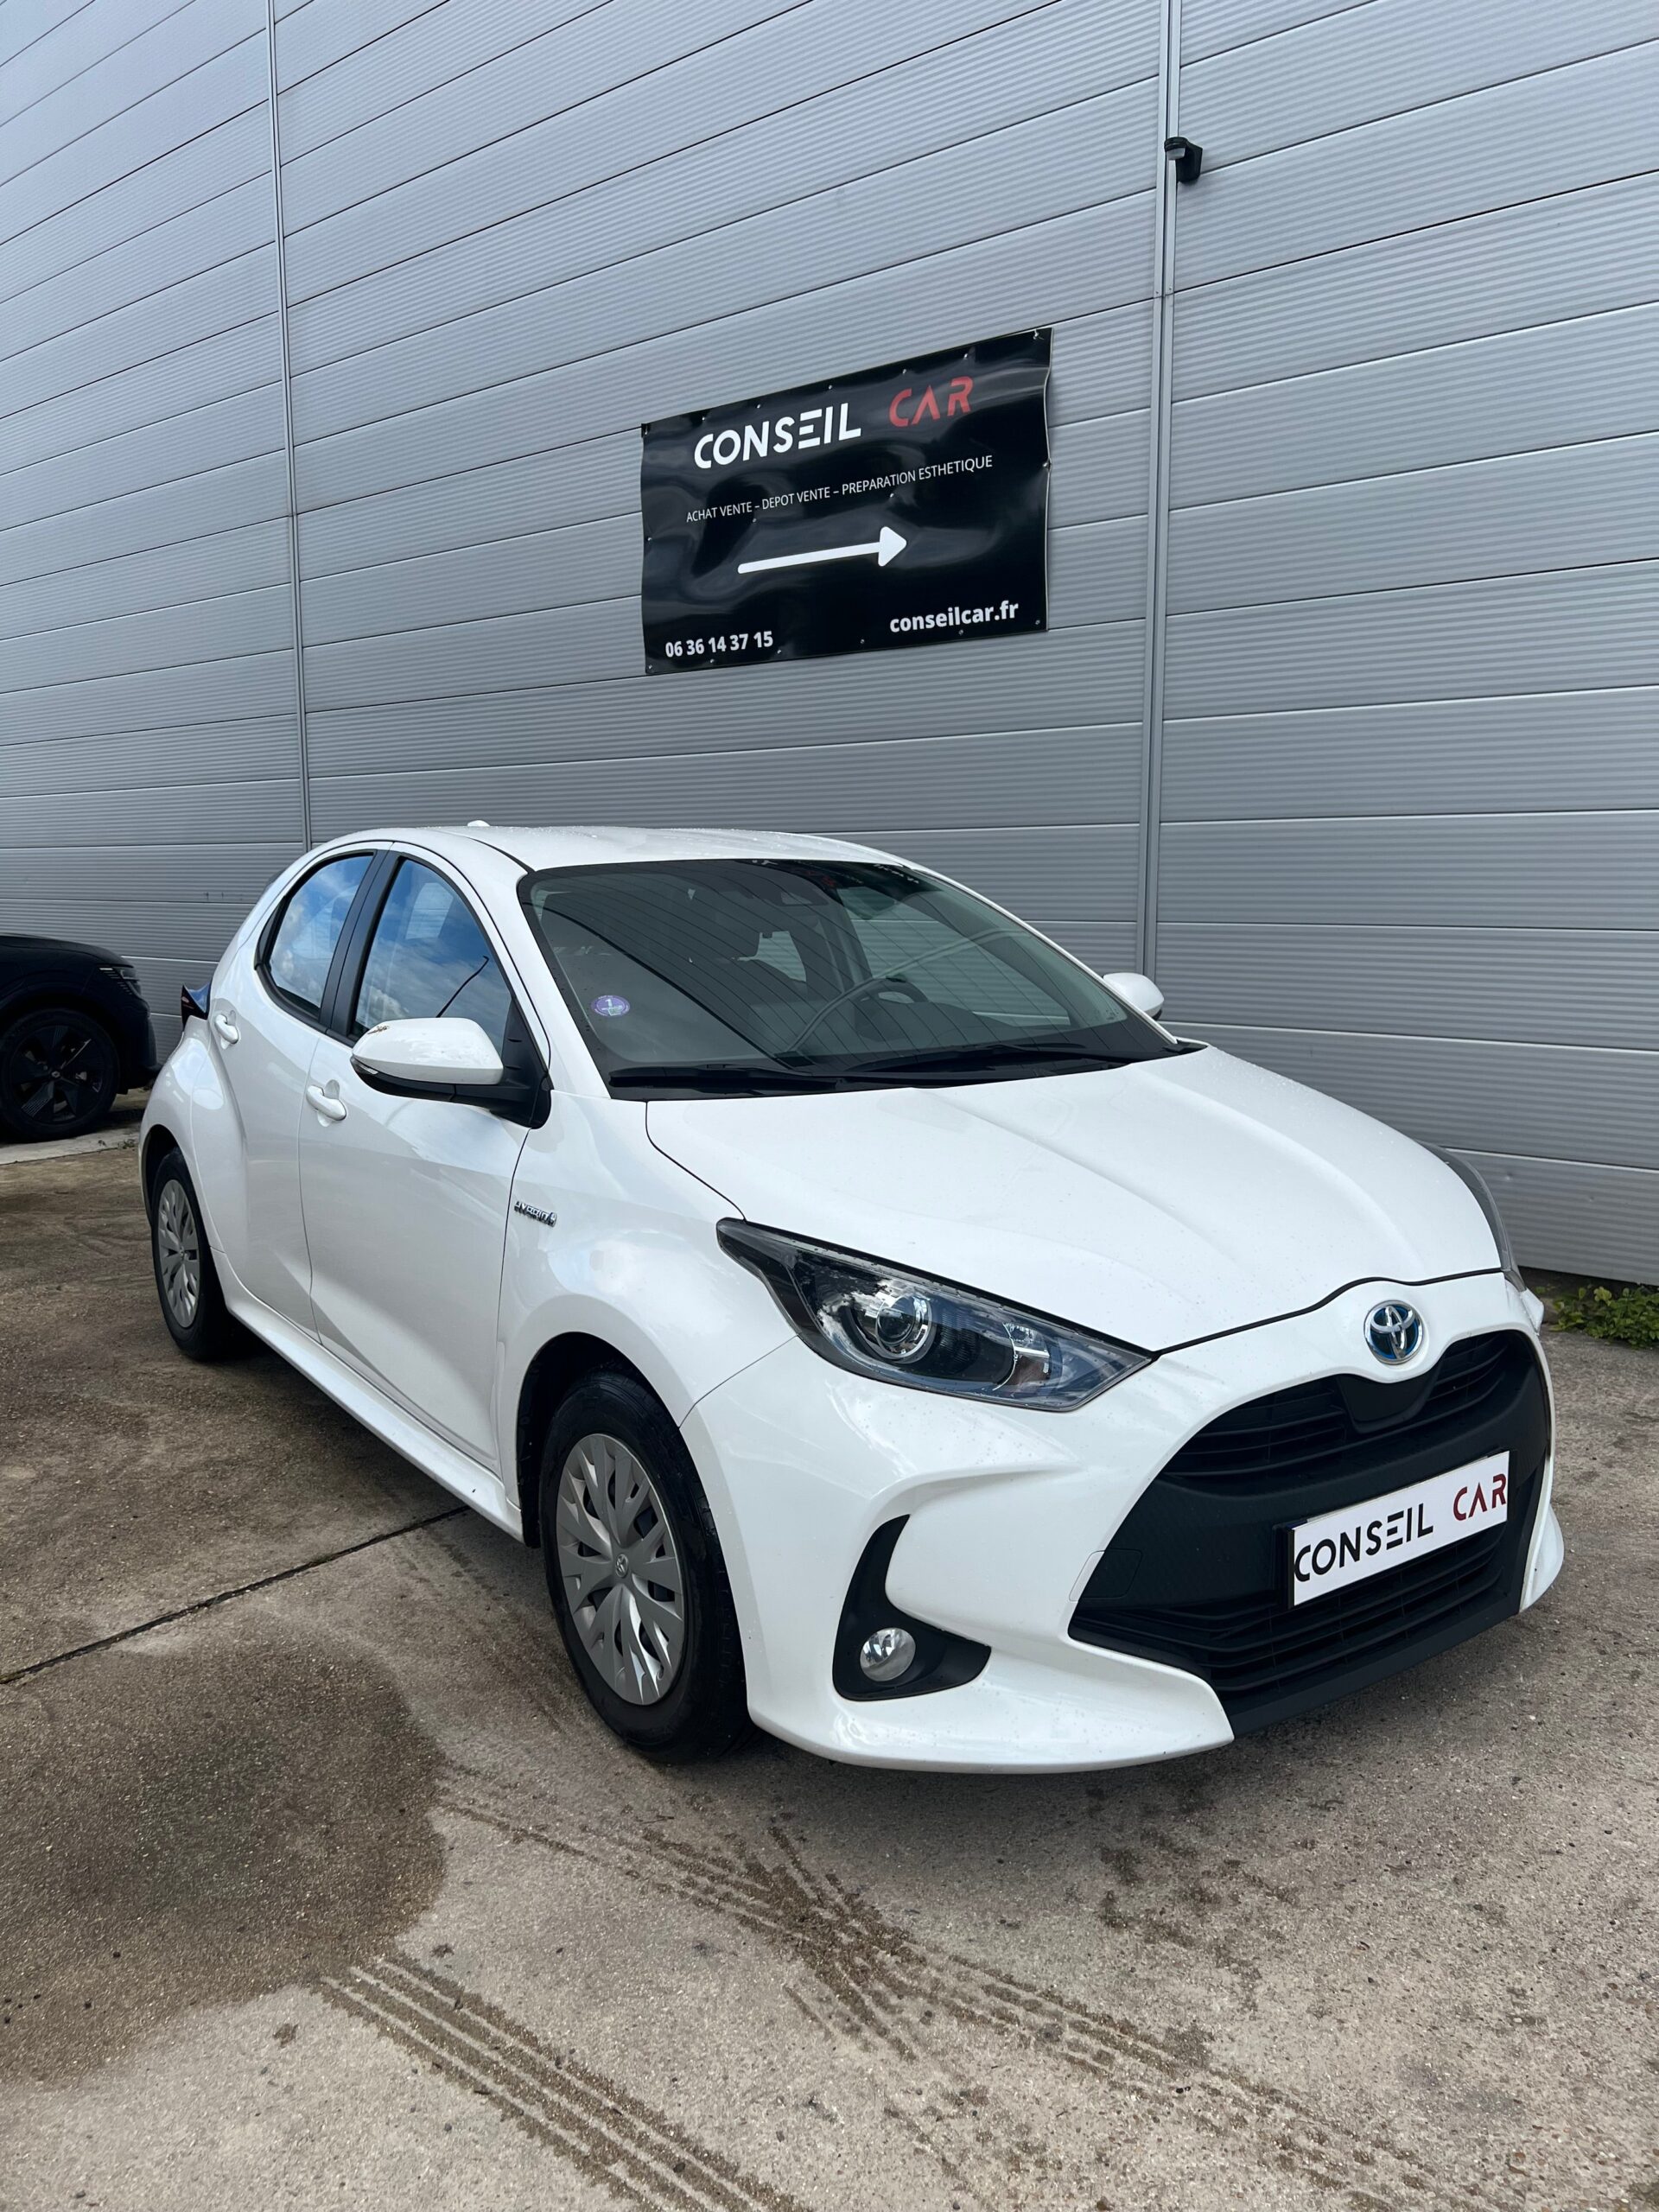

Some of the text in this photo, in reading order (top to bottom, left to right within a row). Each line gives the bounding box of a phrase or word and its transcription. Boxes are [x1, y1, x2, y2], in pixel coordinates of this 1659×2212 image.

[694, 376, 974, 469] CONSEIL CAR
[686, 507, 718, 523] ACHAT
[721, 502, 753, 517] VENTE
[761, 493, 794, 510] DEPOT
[797, 486, 830, 503] VENTE
[842, 470, 916, 495] PREPARATION
[918, 454, 993, 480] ESTHETIQUE
[664, 630, 773, 658] 06 36 14 37 15
[889, 600, 1019, 633] conseilcar.fr
[1294, 1473, 1507, 1582] CONSEIL CAR
